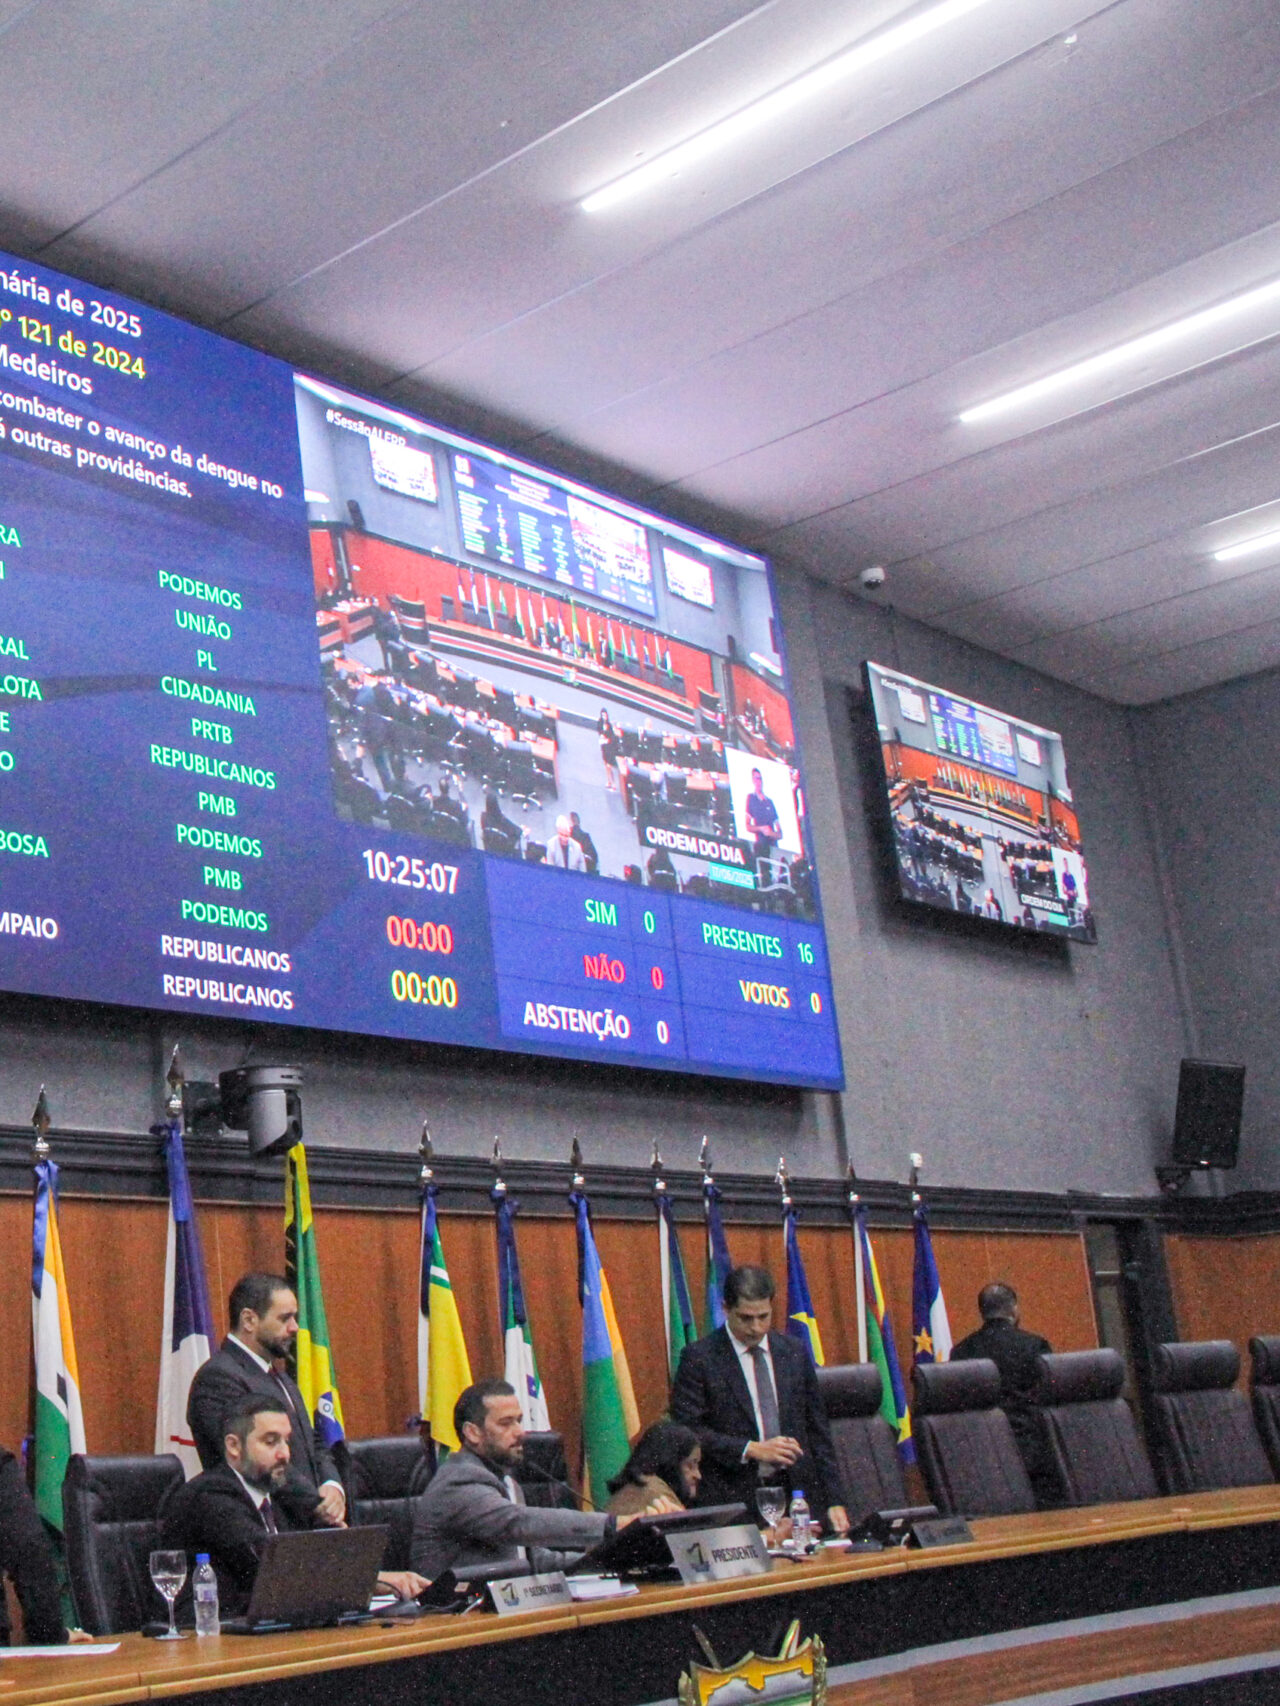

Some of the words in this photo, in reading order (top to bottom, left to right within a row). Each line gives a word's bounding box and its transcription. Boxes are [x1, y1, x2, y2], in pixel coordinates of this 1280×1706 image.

[56, 289, 84, 316] de
[90, 301, 141, 337] 2025
[18, 316, 51, 346] 121
[58, 331, 87, 358] de
[93, 342, 146, 379] 2024
[11, 428, 72, 458] outras
[76, 448, 191, 498] providências.
[87, 421, 100, 436] o
[105, 427, 166, 460] avanço
[170, 445, 192, 468] da
[196, 454, 257, 490] dengue
[261, 480, 282, 498] no
[158, 570, 243, 611] PODEMOS
[175, 609, 233, 641] UNIÃO
[196, 649, 218, 671] PL
[160, 676, 257, 716] CIDADANIA
[190, 718, 234, 745] PRTB
[150, 744, 277, 790] REPUBLICANOS
[198, 791, 237, 817] PMB
[176, 824, 263, 858] PODEMOS
[646, 826, 698, 853] ORDEM
[699, 838, 720, 858] DO
[720, 844, 746, 865] DIA
[203, 866, 243, 890] PMB
[363, 849, 457, 894] 10:25:07
[181, 899, 268, 932] PODEMOS
[584, 899, 618, 926] SIM
[643, 911, 656, 934] 0
[386, 915, 454, 955] 00:00
[702, 923, 783, 958] PRESENTES
[161, 935, 290, 972] REPUBLICANOS
[583, 953, 626, 983] NÃO
[797, 942, 815, 964] 16
[163, 974, 293, 1010] REPUBLICANOS
[391, 970, 456, 1008] 00:00
[651, 966, 664, 990] 0
[739, 980, 789, 1008] VOTOS
[810, 992, 820, 1013] 0
[523, 1001, 629, 1041] ABSTENÇÃO
[656, 1021, 668, 1044] 0
[711, 1544, 759, 1564] PRESIDENTE
